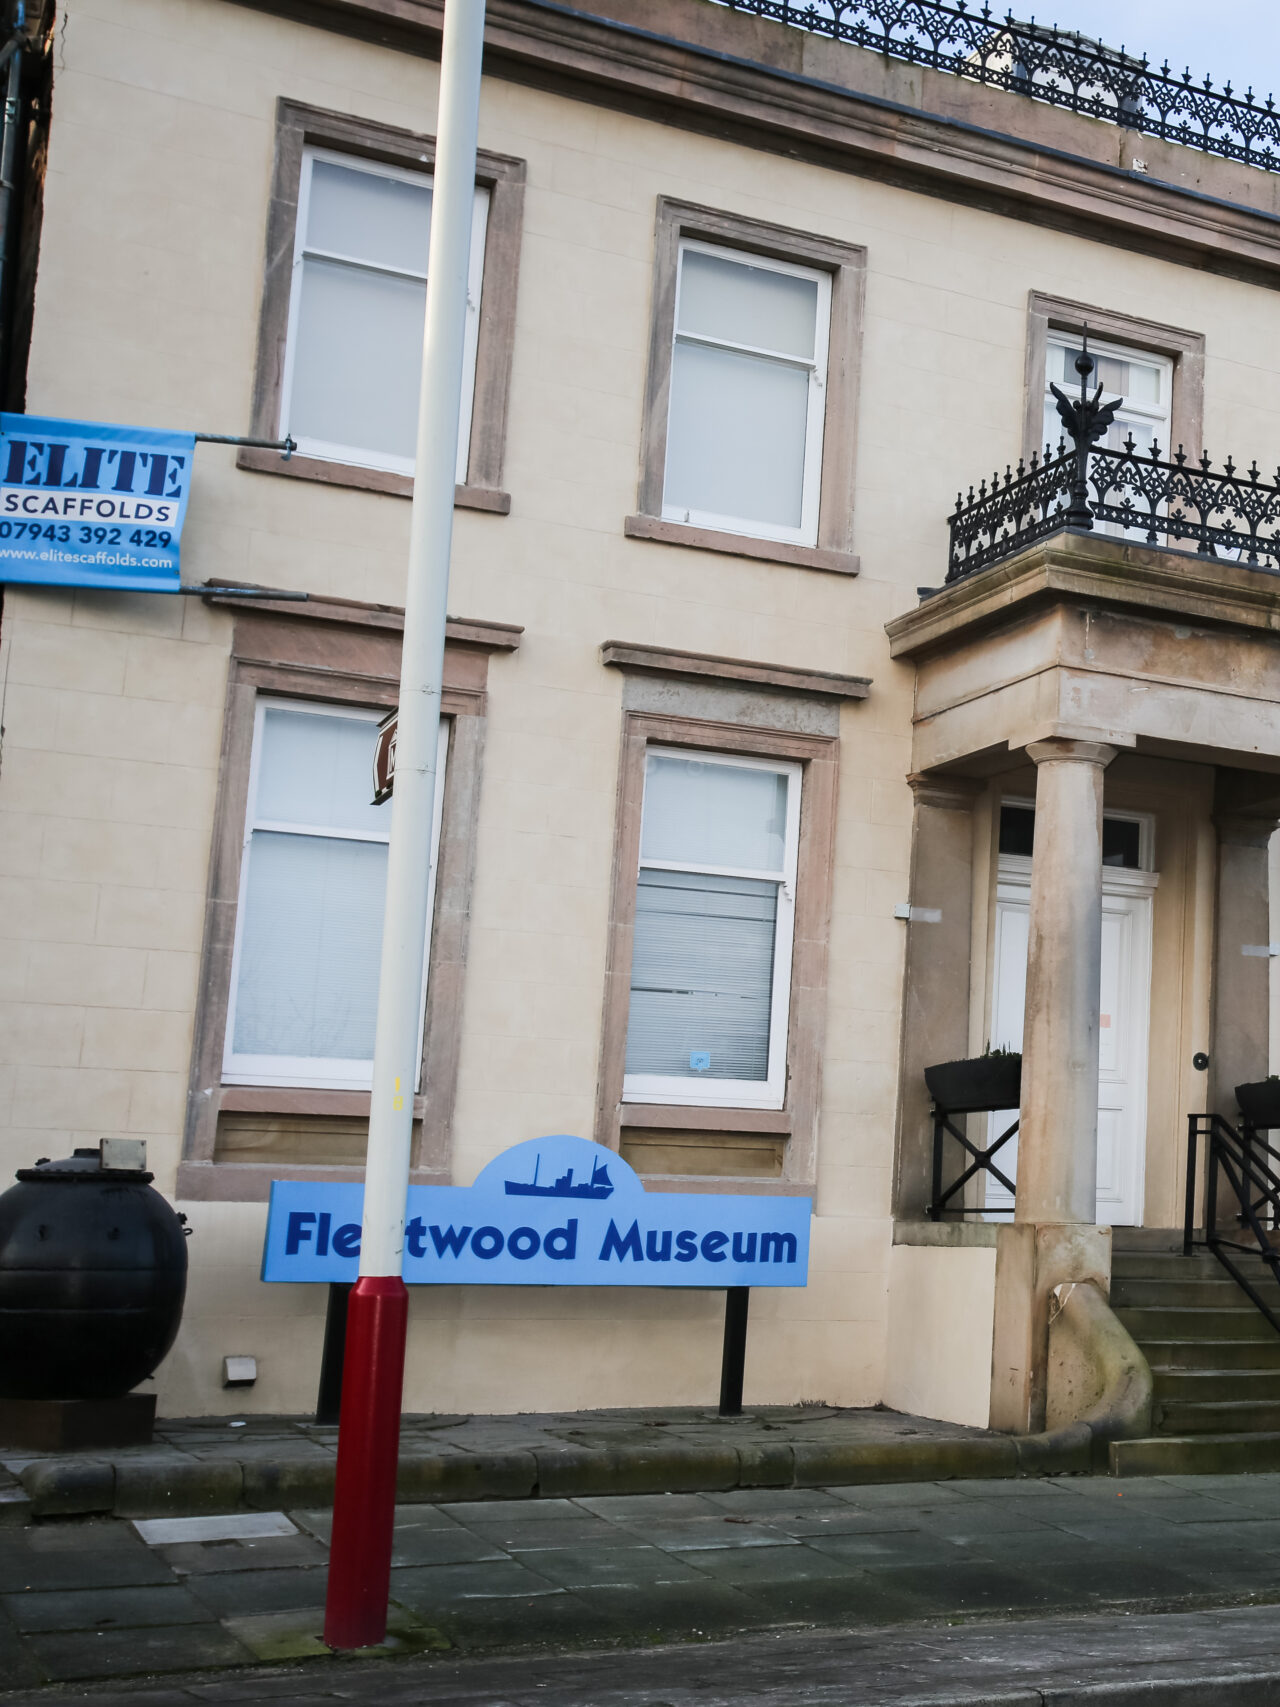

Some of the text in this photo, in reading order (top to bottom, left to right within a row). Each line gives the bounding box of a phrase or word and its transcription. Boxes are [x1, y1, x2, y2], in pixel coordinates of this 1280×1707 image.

[3, 440, 186, 498] ELITE
[4, 494, 171, 522] SCAFFOLDS
[0, 521, 172, 549] 07943 392 429
[0, 549, 173, 569] www.elitescaffolds.com
[285, 1211, 798, 1264] Fletwood Museum
